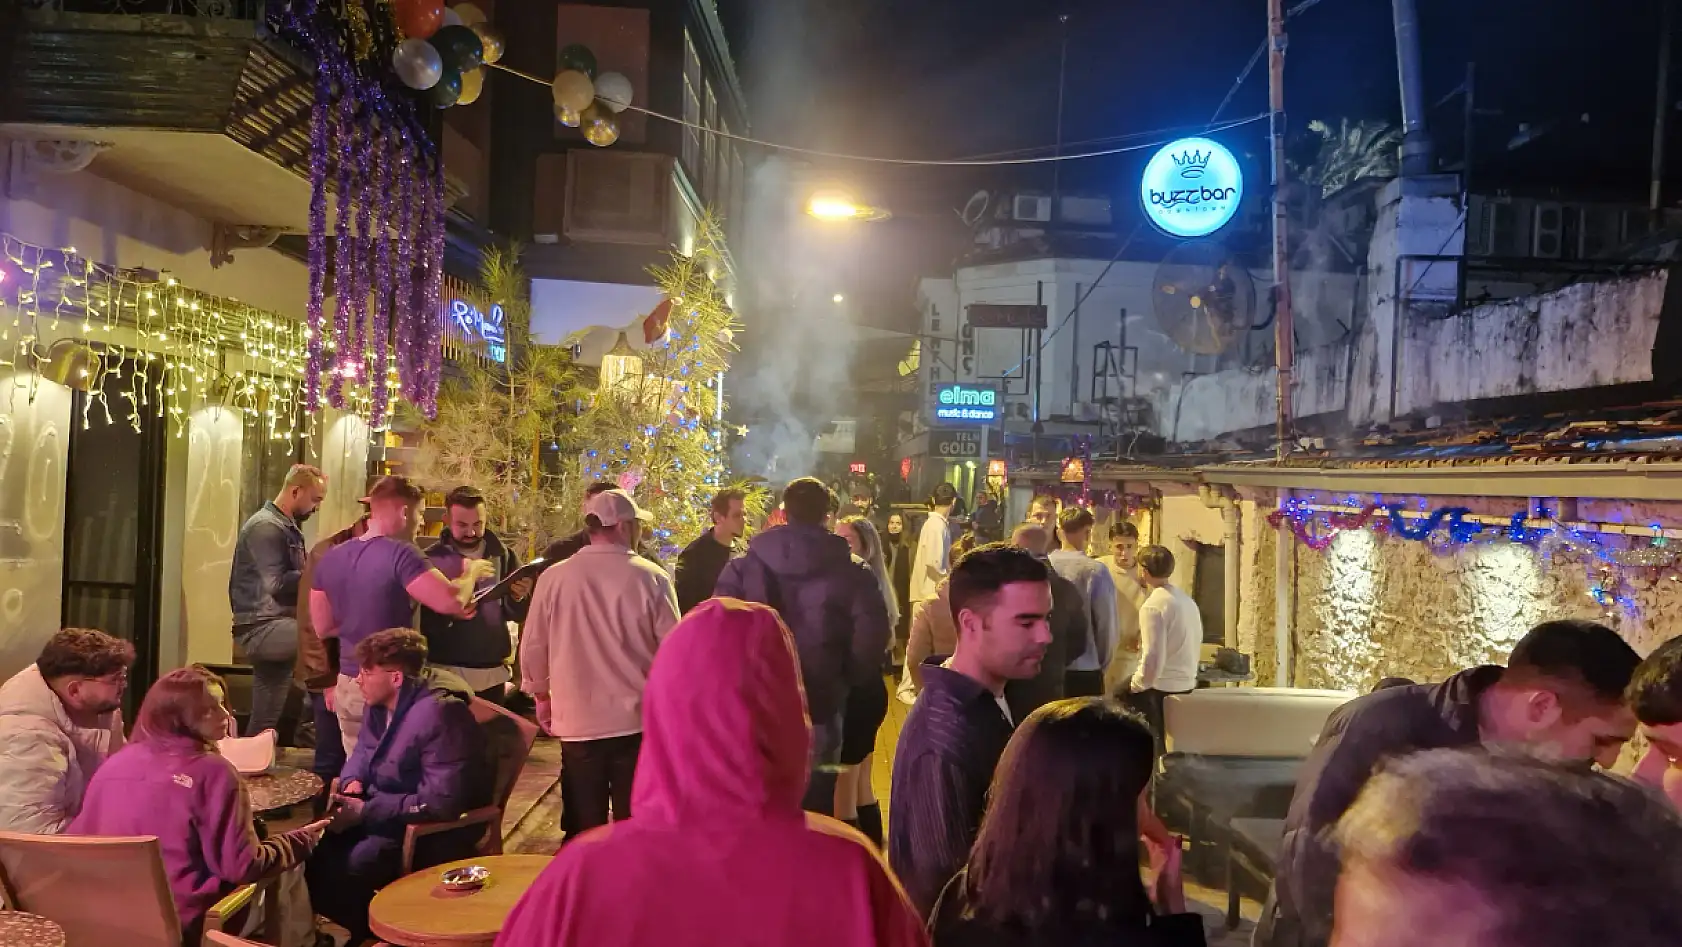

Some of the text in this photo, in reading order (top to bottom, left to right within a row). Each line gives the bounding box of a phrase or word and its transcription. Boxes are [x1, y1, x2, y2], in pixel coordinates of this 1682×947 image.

[940, 386, 995, 405] elma
[938, 408, 960, 418] music
[969, 409, 994, 419] dance
[939, 441, 976, 455] GOLD
